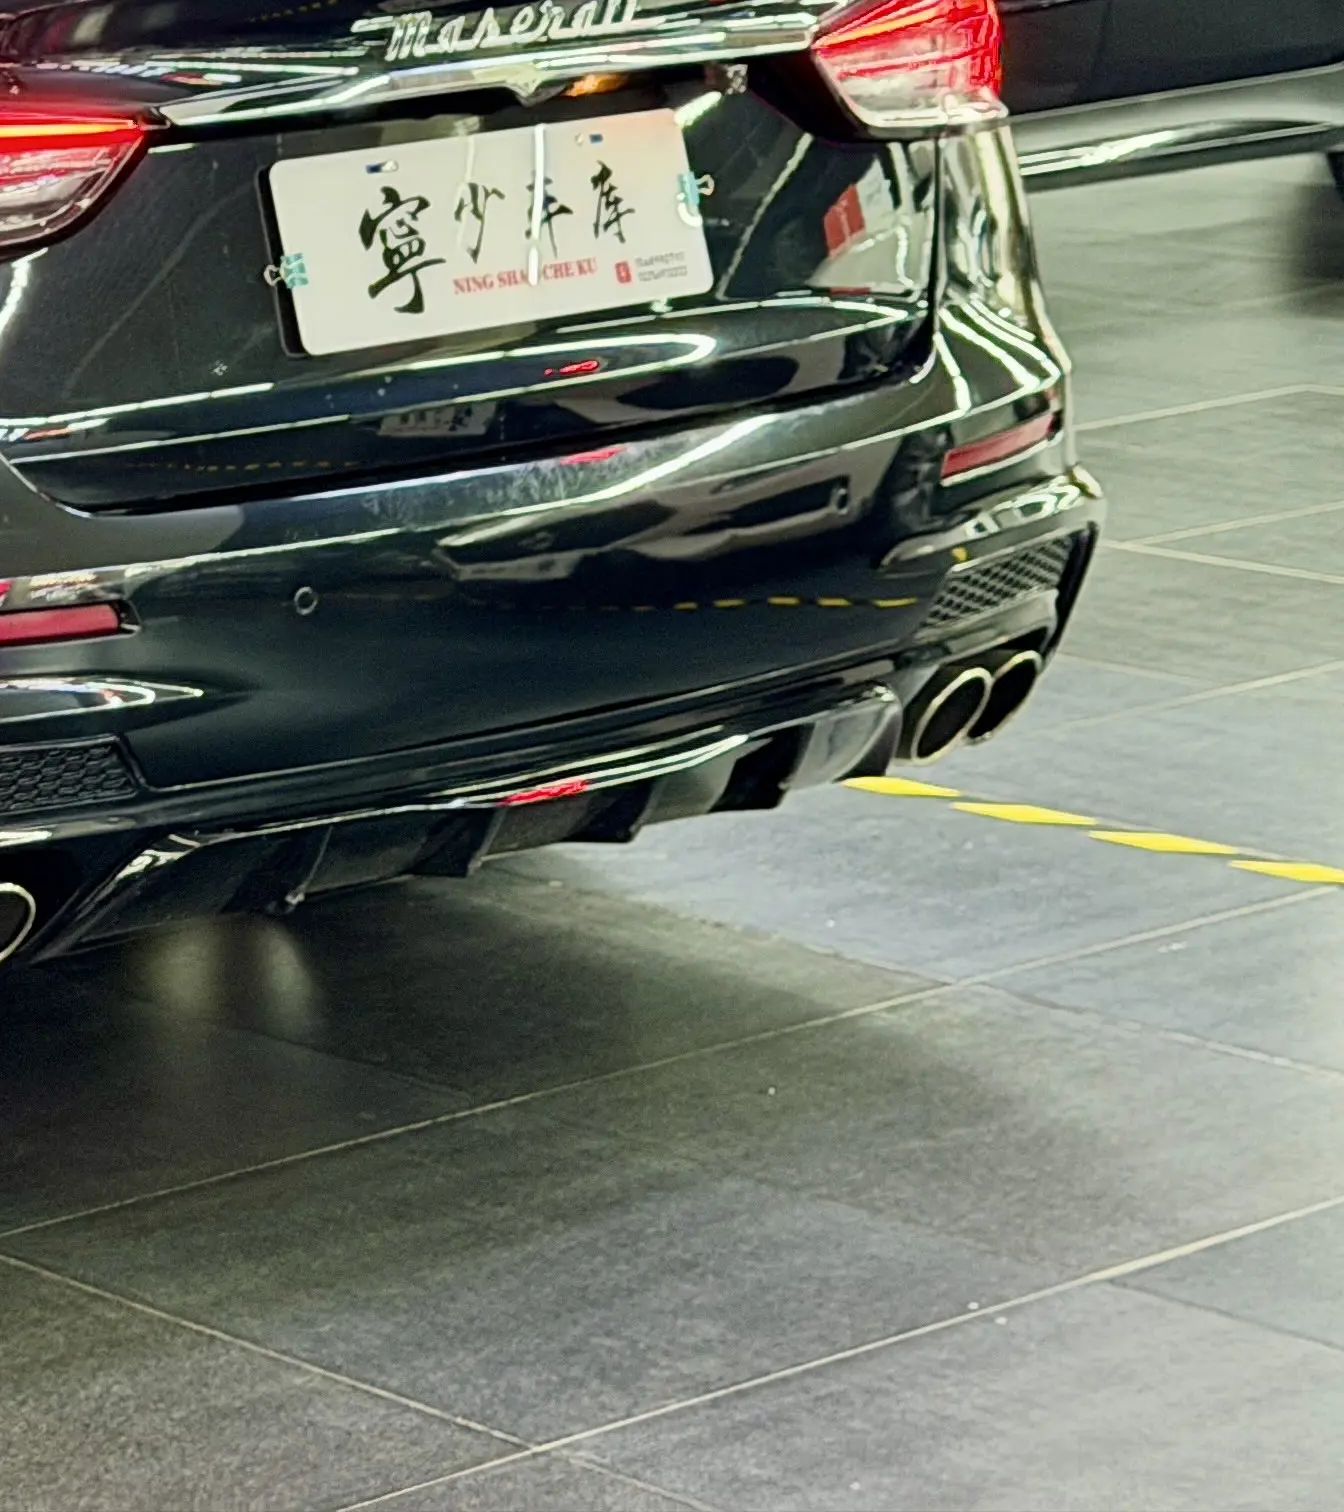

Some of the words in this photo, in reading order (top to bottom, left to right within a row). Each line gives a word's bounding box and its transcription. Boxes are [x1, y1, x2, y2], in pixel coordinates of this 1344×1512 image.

[453, 273, 494, 295] NING
[542, 261, 574, 280] CHE
[576, 256, 598, 276] KU
